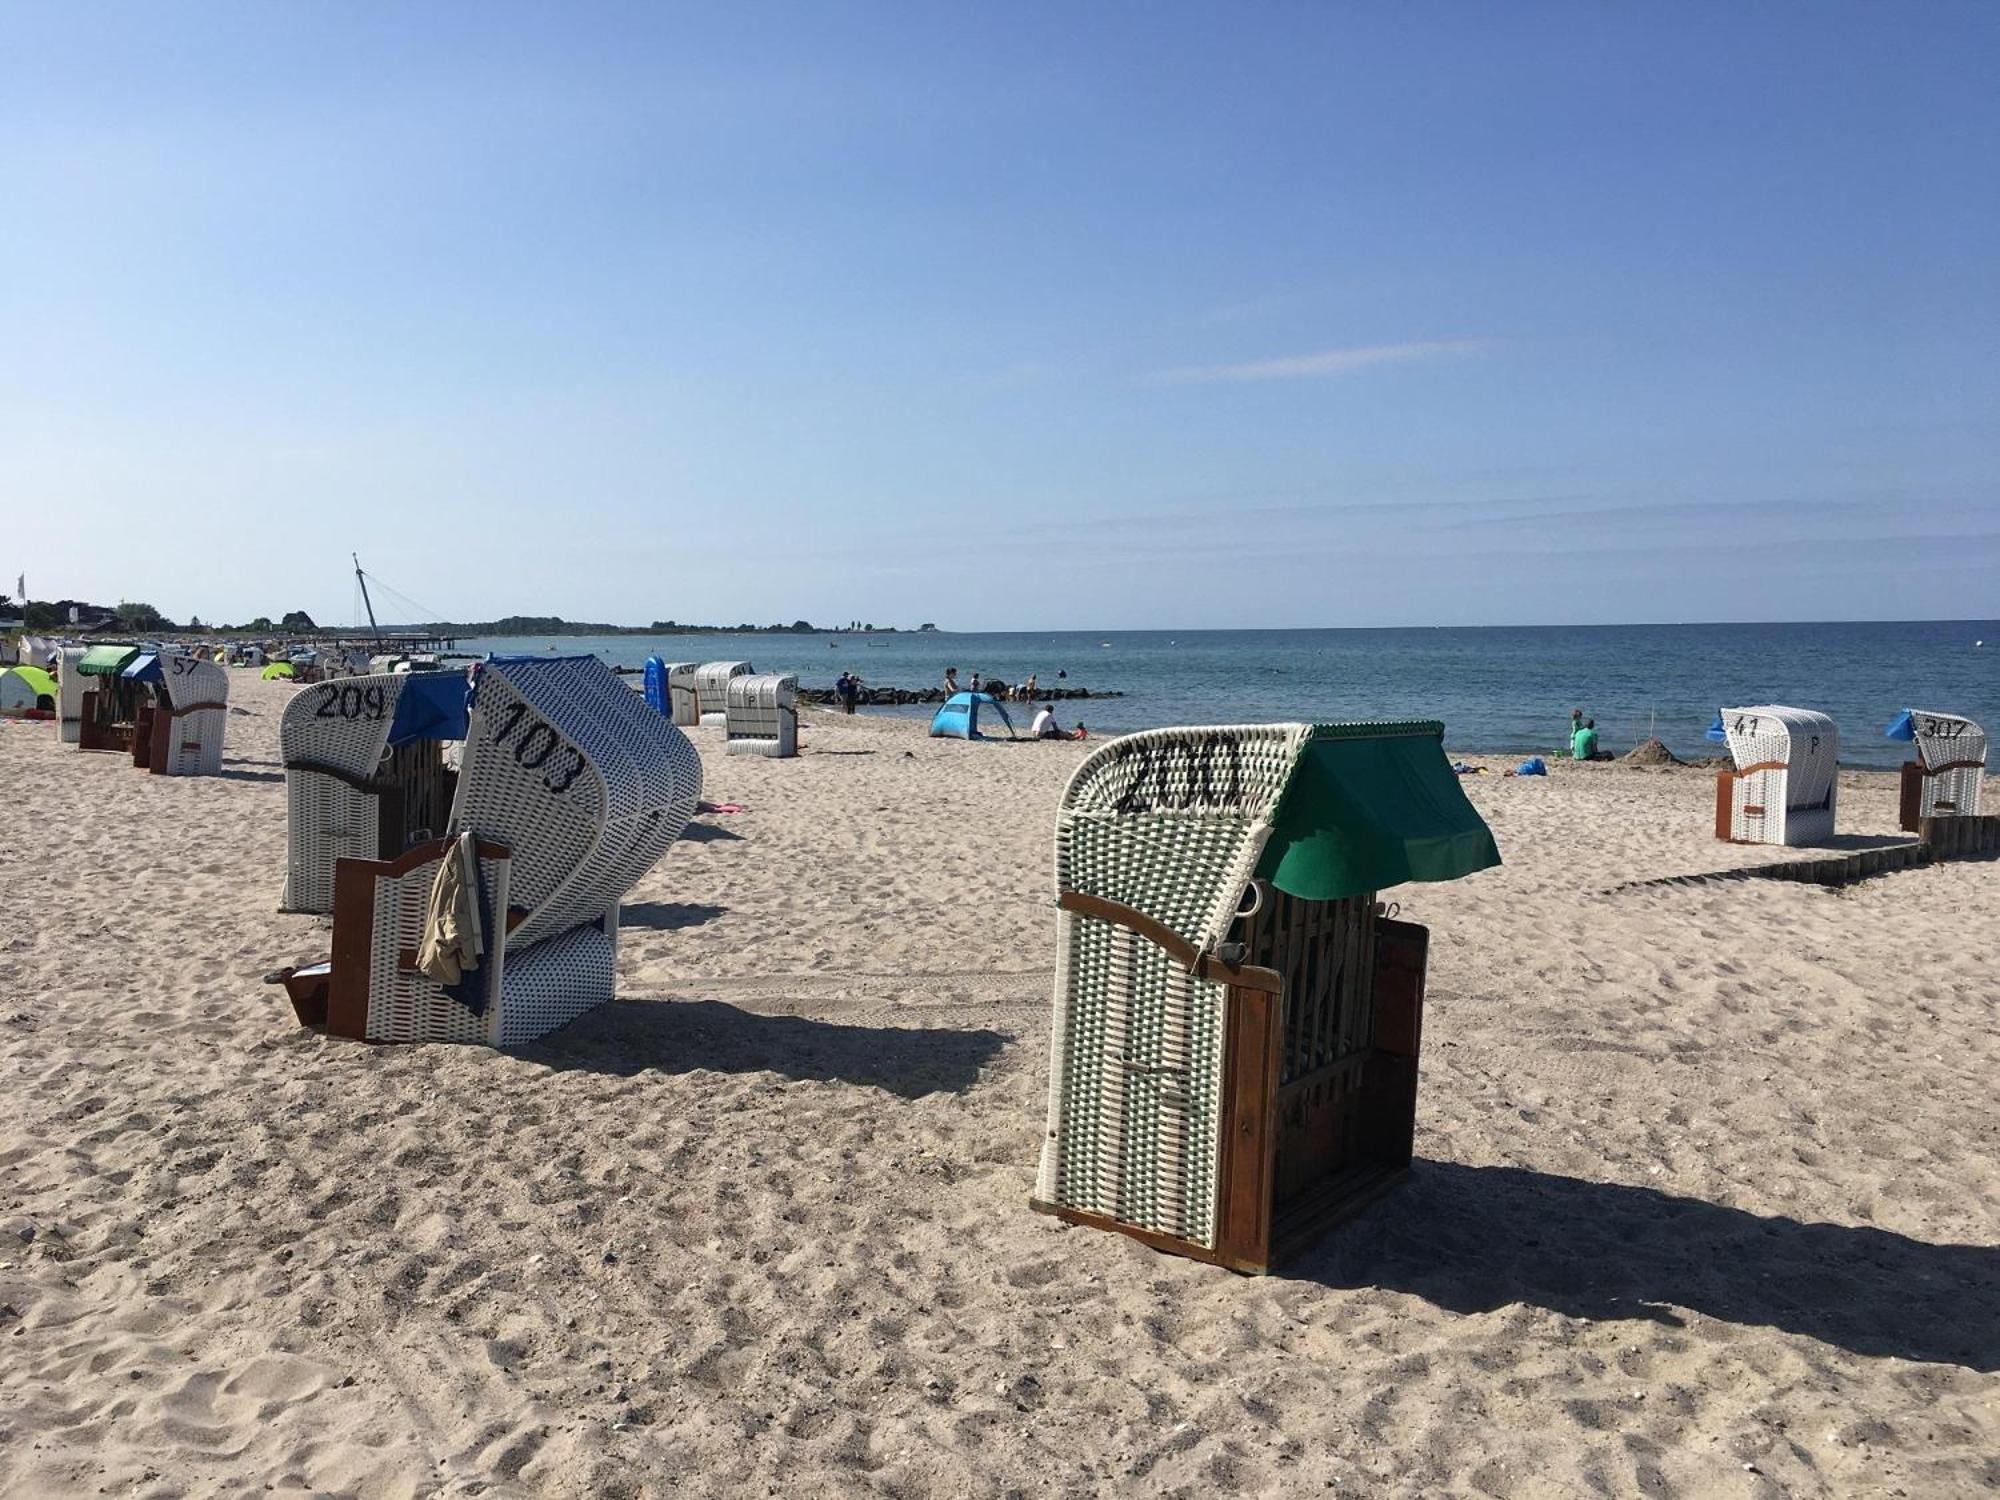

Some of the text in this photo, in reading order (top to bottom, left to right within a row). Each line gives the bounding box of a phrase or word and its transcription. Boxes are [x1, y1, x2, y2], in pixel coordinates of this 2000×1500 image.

[173, 657, 199, 676] 57
[317, 684, 383, 720] 209
[748, 695, 756, 707] P
[1734, 716, 1758, 738] 41
[1923, 718, 1967, 740] 307
[495, 702, 585, 794] 103
[1811, 736, 1819, 754] P
[1112, 734, 1241, 814] 200
